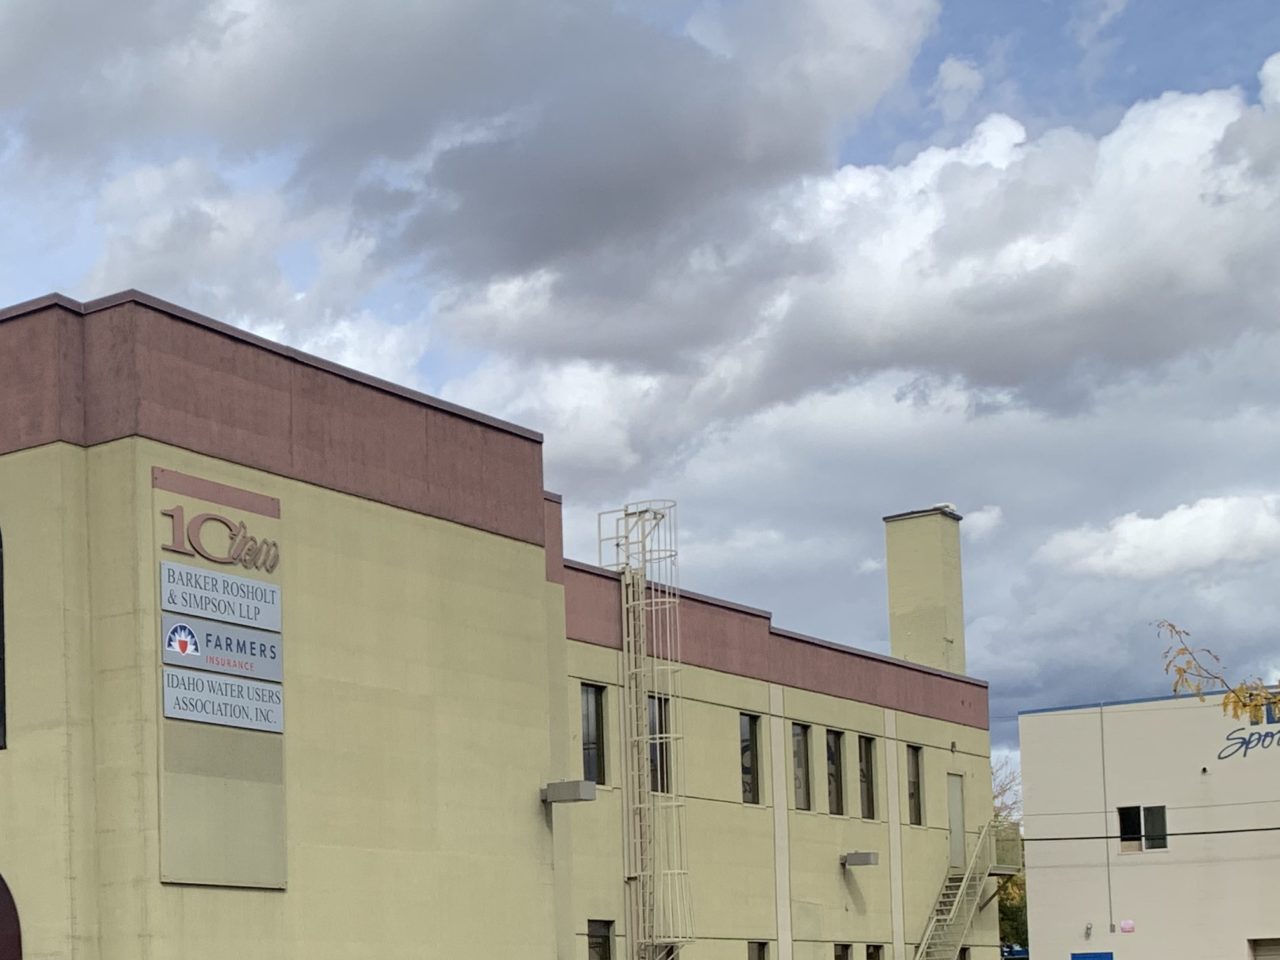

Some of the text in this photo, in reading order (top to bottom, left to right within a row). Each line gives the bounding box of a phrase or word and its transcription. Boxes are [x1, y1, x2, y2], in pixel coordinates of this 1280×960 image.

[167, 568, 277, 605] BARKER ROSHOLT
[167, 588, 260, 621] & SIMPSON LLP
[205, 633, 277, 660] FARMERS
[205, 655, 256, 672] INSURANCE
[167, 673, 282, 705] IDAHO WATER USERS
[173, 696, 277, 724] ASSOCIATION, INC.
